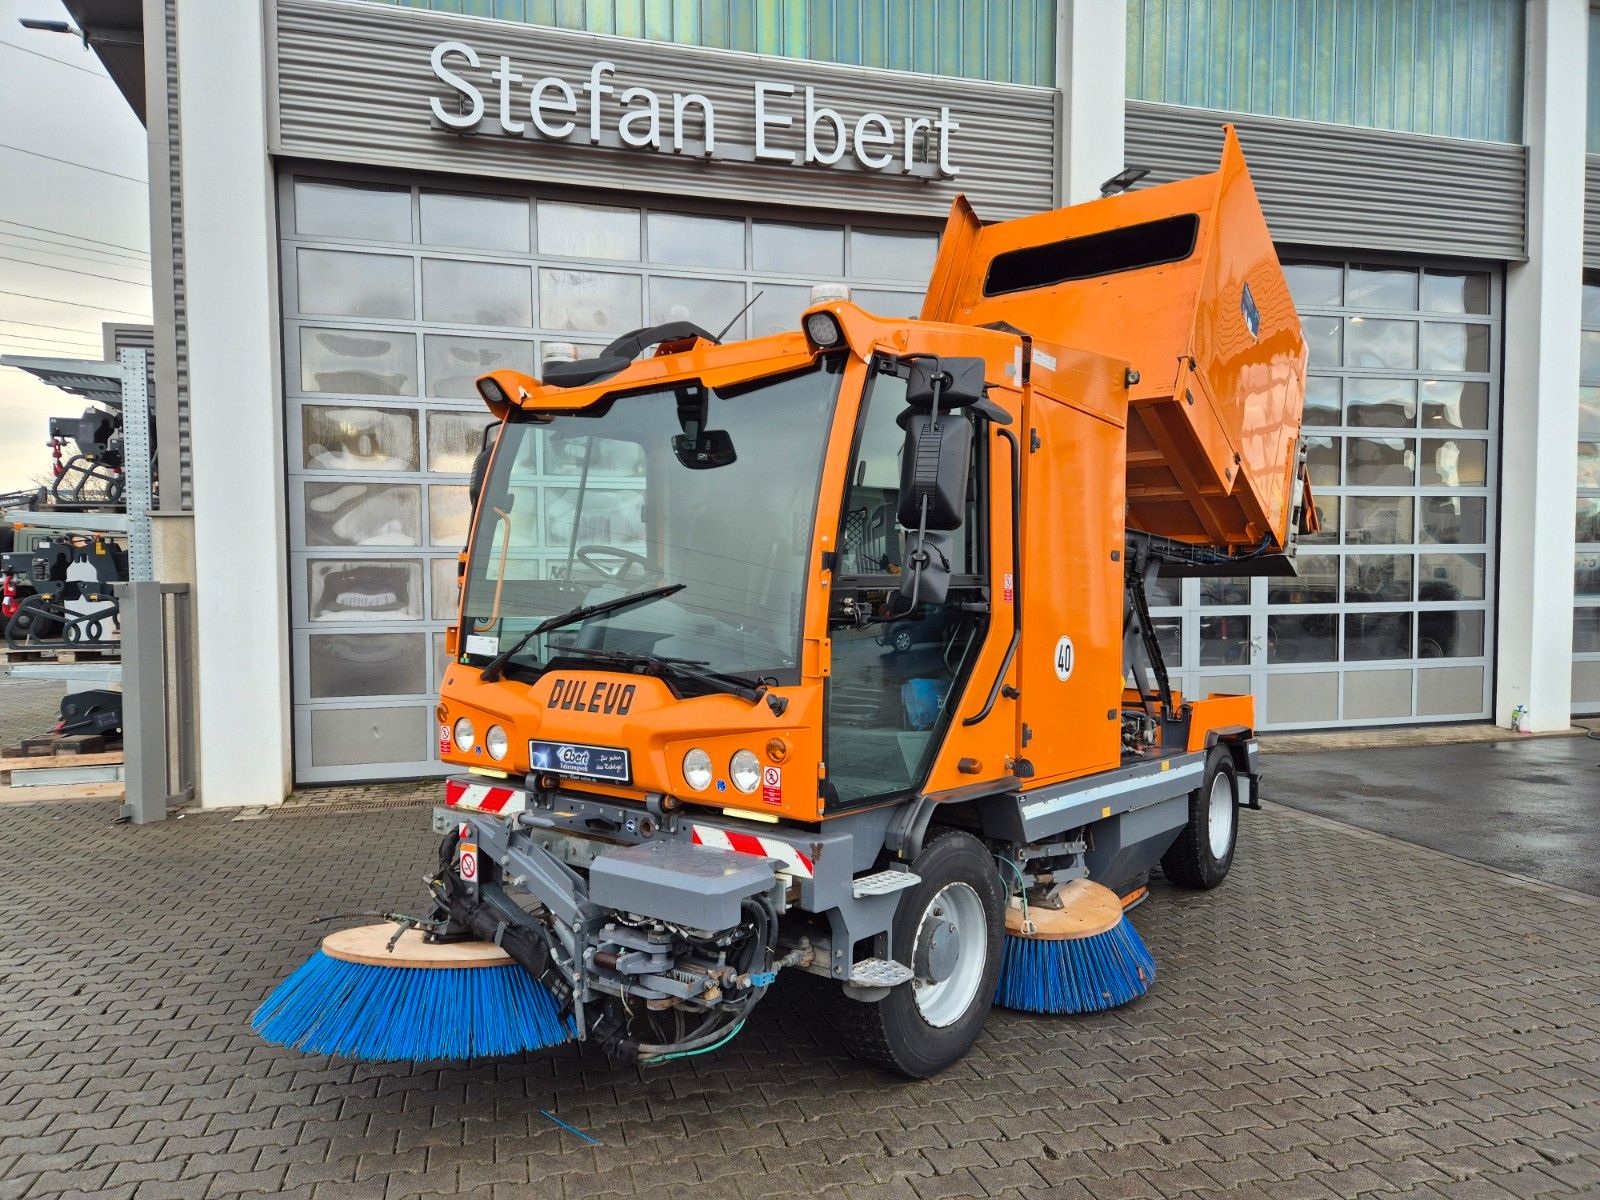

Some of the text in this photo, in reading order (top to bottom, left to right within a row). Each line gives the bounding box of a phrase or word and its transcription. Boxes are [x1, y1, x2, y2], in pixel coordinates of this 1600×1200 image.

[428, 41, 961, 178] Stefan Ebert
[1057, 643, 1071, 672] 40
[547, 679, 637, 715] DULEVO
[563, 748, 588, 765] Ebert
